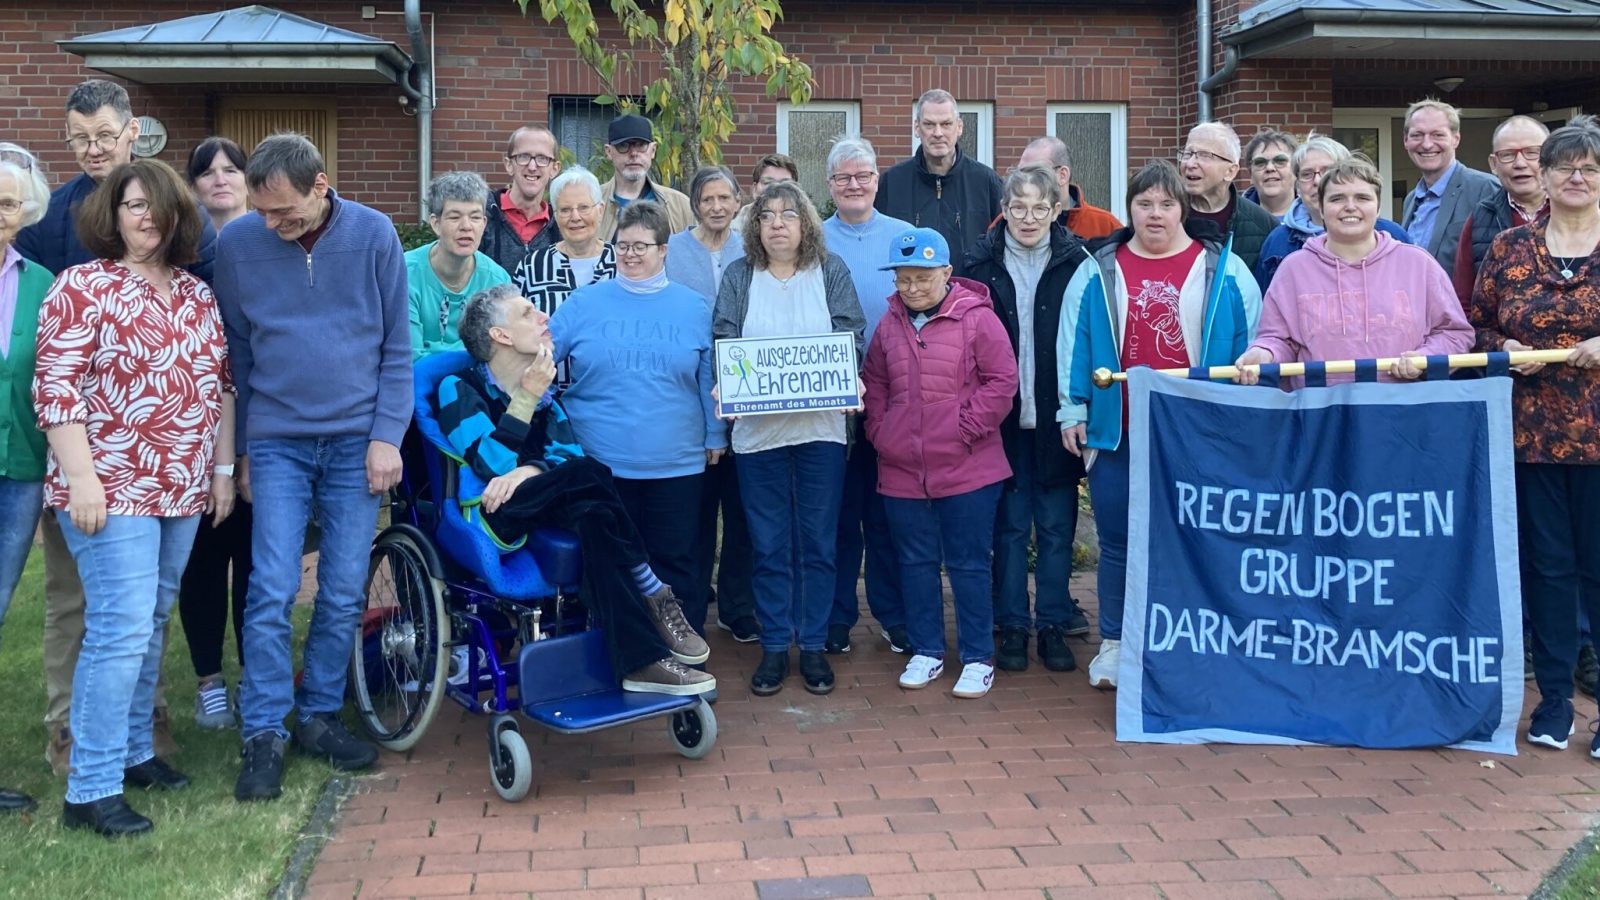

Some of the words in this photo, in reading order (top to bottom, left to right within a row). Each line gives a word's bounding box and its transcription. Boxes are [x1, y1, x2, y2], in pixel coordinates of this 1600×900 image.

[601, 318, 682, 346] CLEAR
[1128, 310, 1140, 360] NICE
[607, 349, 673, 371] VIEW
[757, 368, 851, 396] Ehrenamt
[734, 402, 783, 412] Ehrenamt
[787, 399, 806, 408] des
[808, 397, 847, 408] Monats
[1240, 547, 1395, 606] GRUPPE
[1149, 602, 1499, 684] DARME-BRAMSCHE
